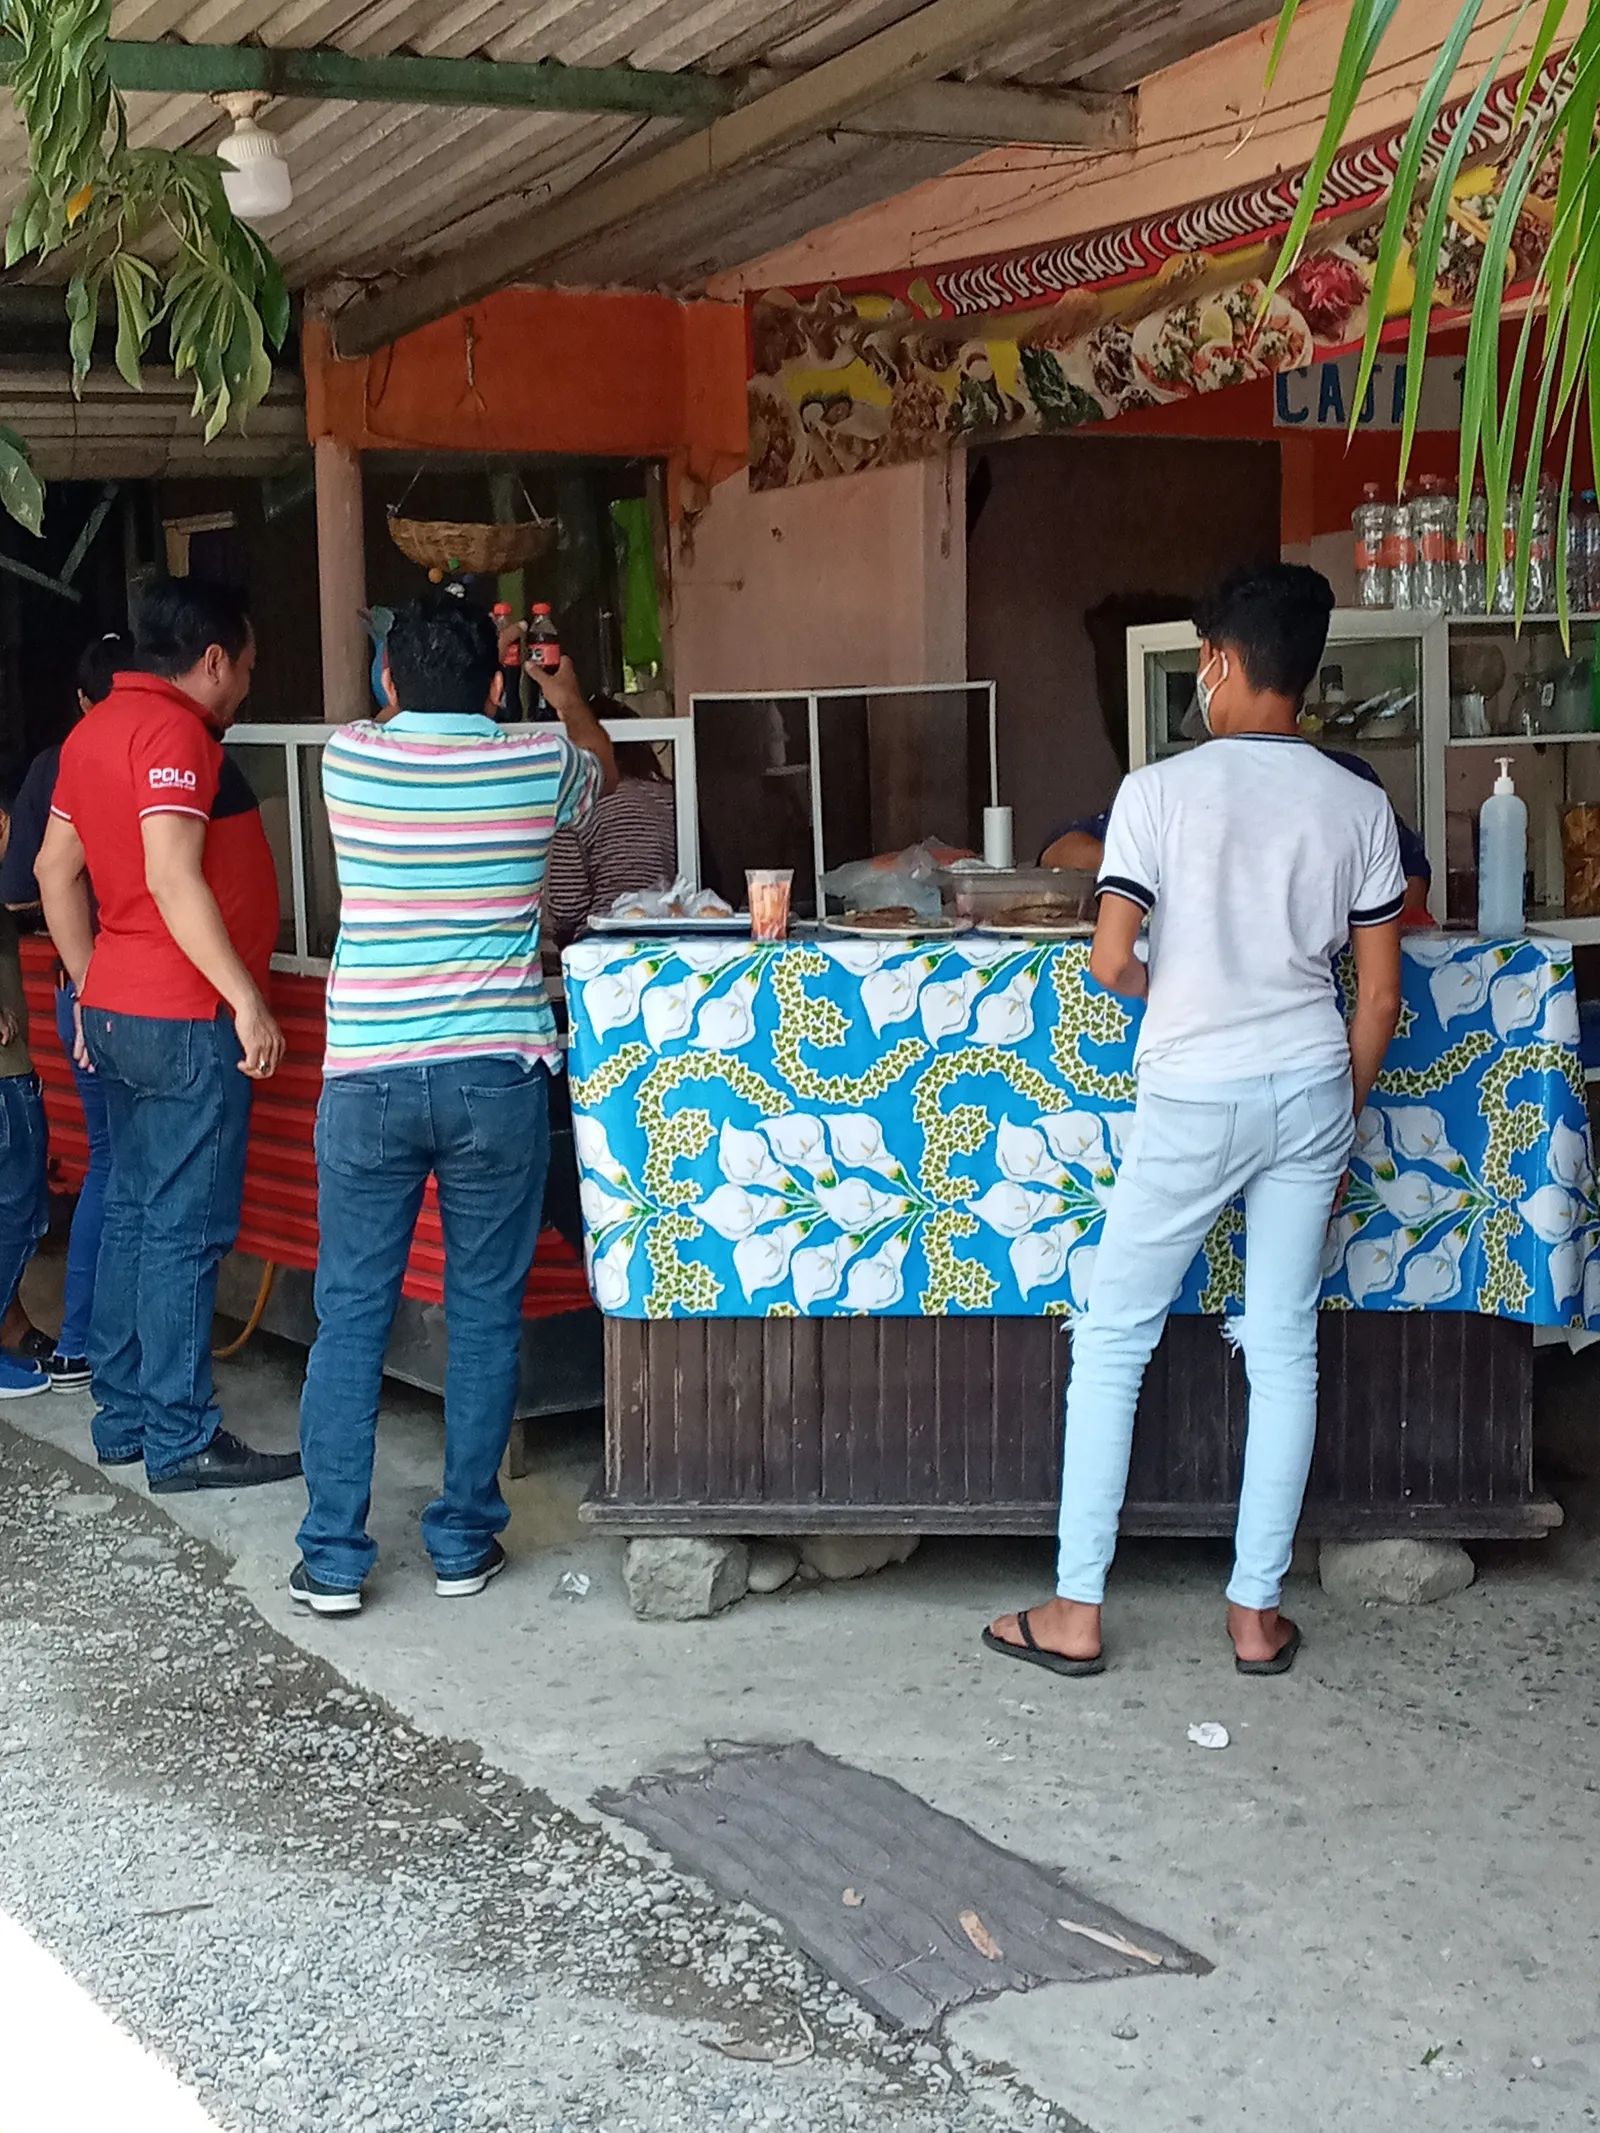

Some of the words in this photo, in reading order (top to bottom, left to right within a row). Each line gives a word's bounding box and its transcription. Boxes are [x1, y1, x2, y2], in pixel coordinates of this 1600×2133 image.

[936, 263, 1014, 316] TACOS
[1002, 256, 1044, 299] DE
[1032, 227, 1146, 291] GUISADO
[1140, 219, 1167, 260] Y
[1159, 177, 1296, 252] CARNITAS
[149, 767, 196, 786] POLO
